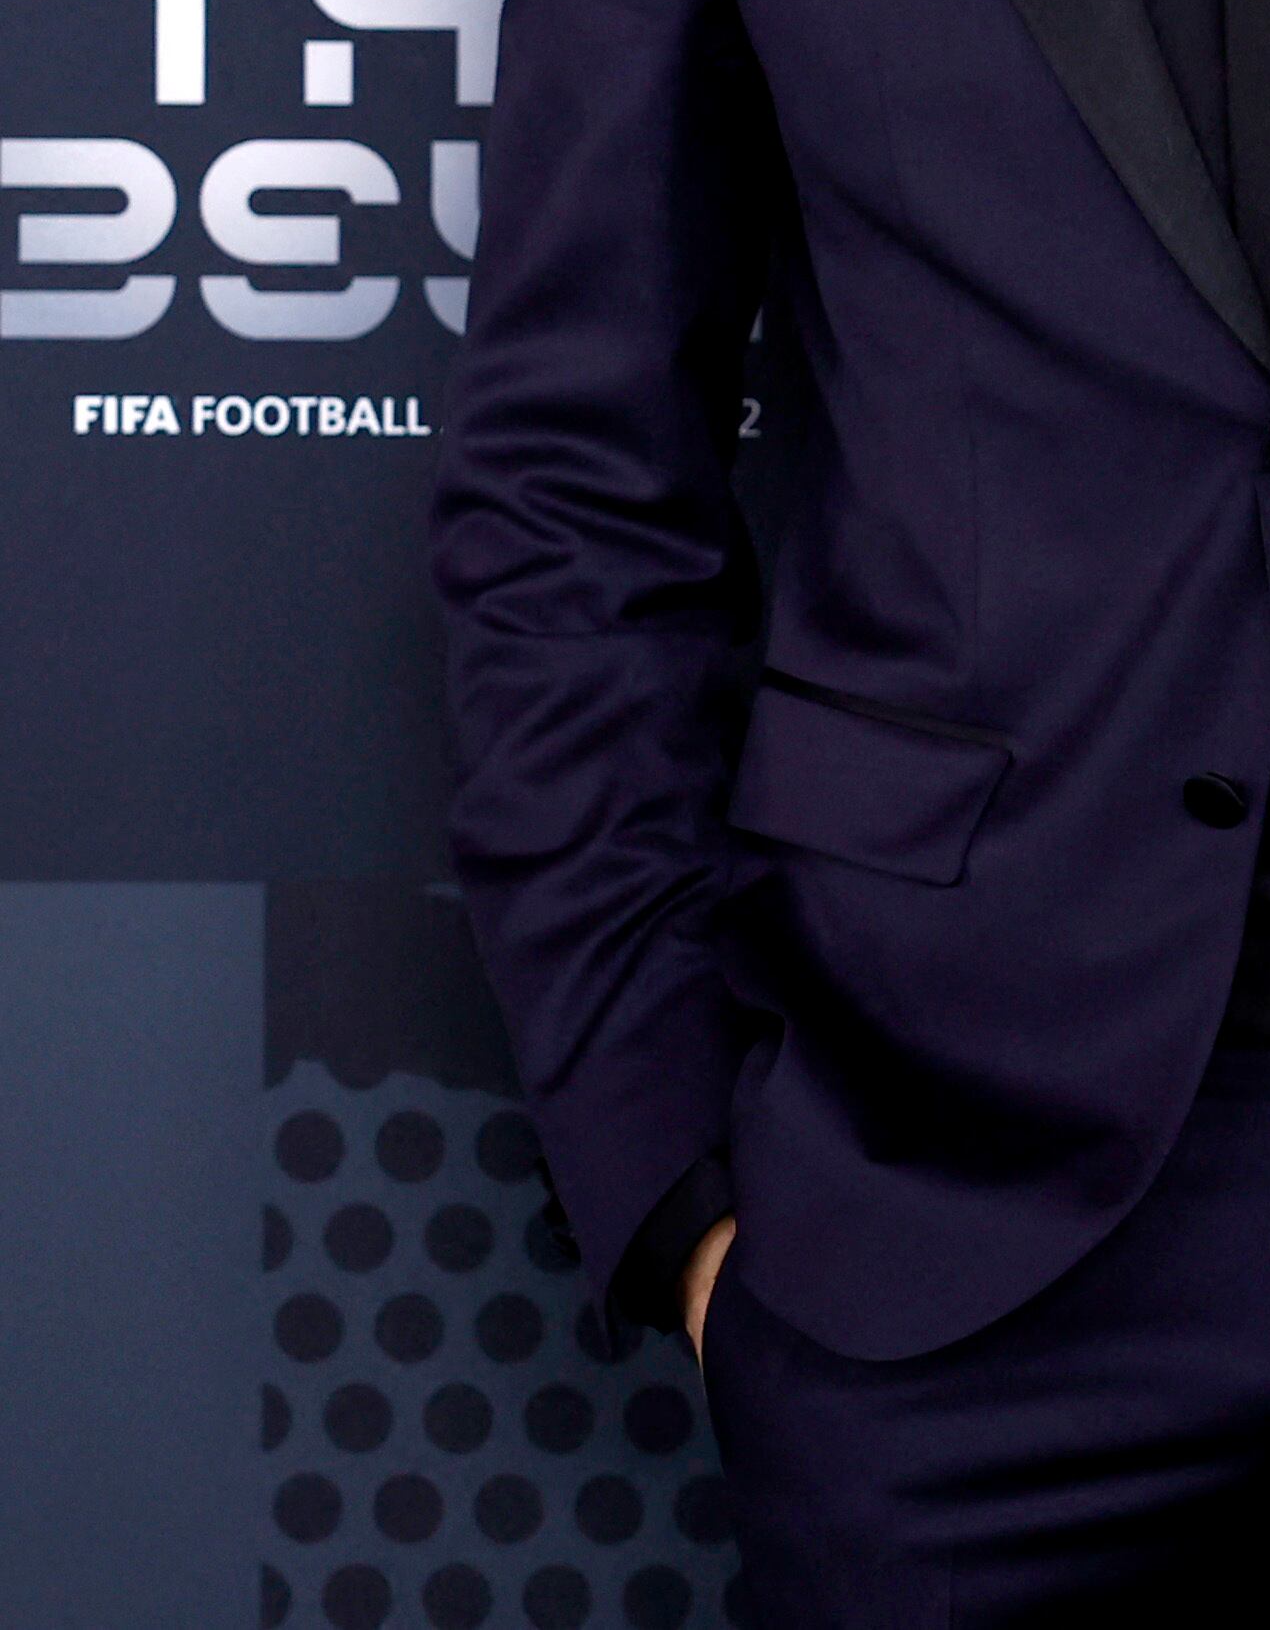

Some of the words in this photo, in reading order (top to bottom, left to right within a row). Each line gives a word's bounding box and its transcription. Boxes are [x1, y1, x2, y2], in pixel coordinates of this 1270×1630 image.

[0, 138, 481, 341] BE
[73, 394, 182, 436] FIFA
[191, 395, 433, 437] FOOTBALL
